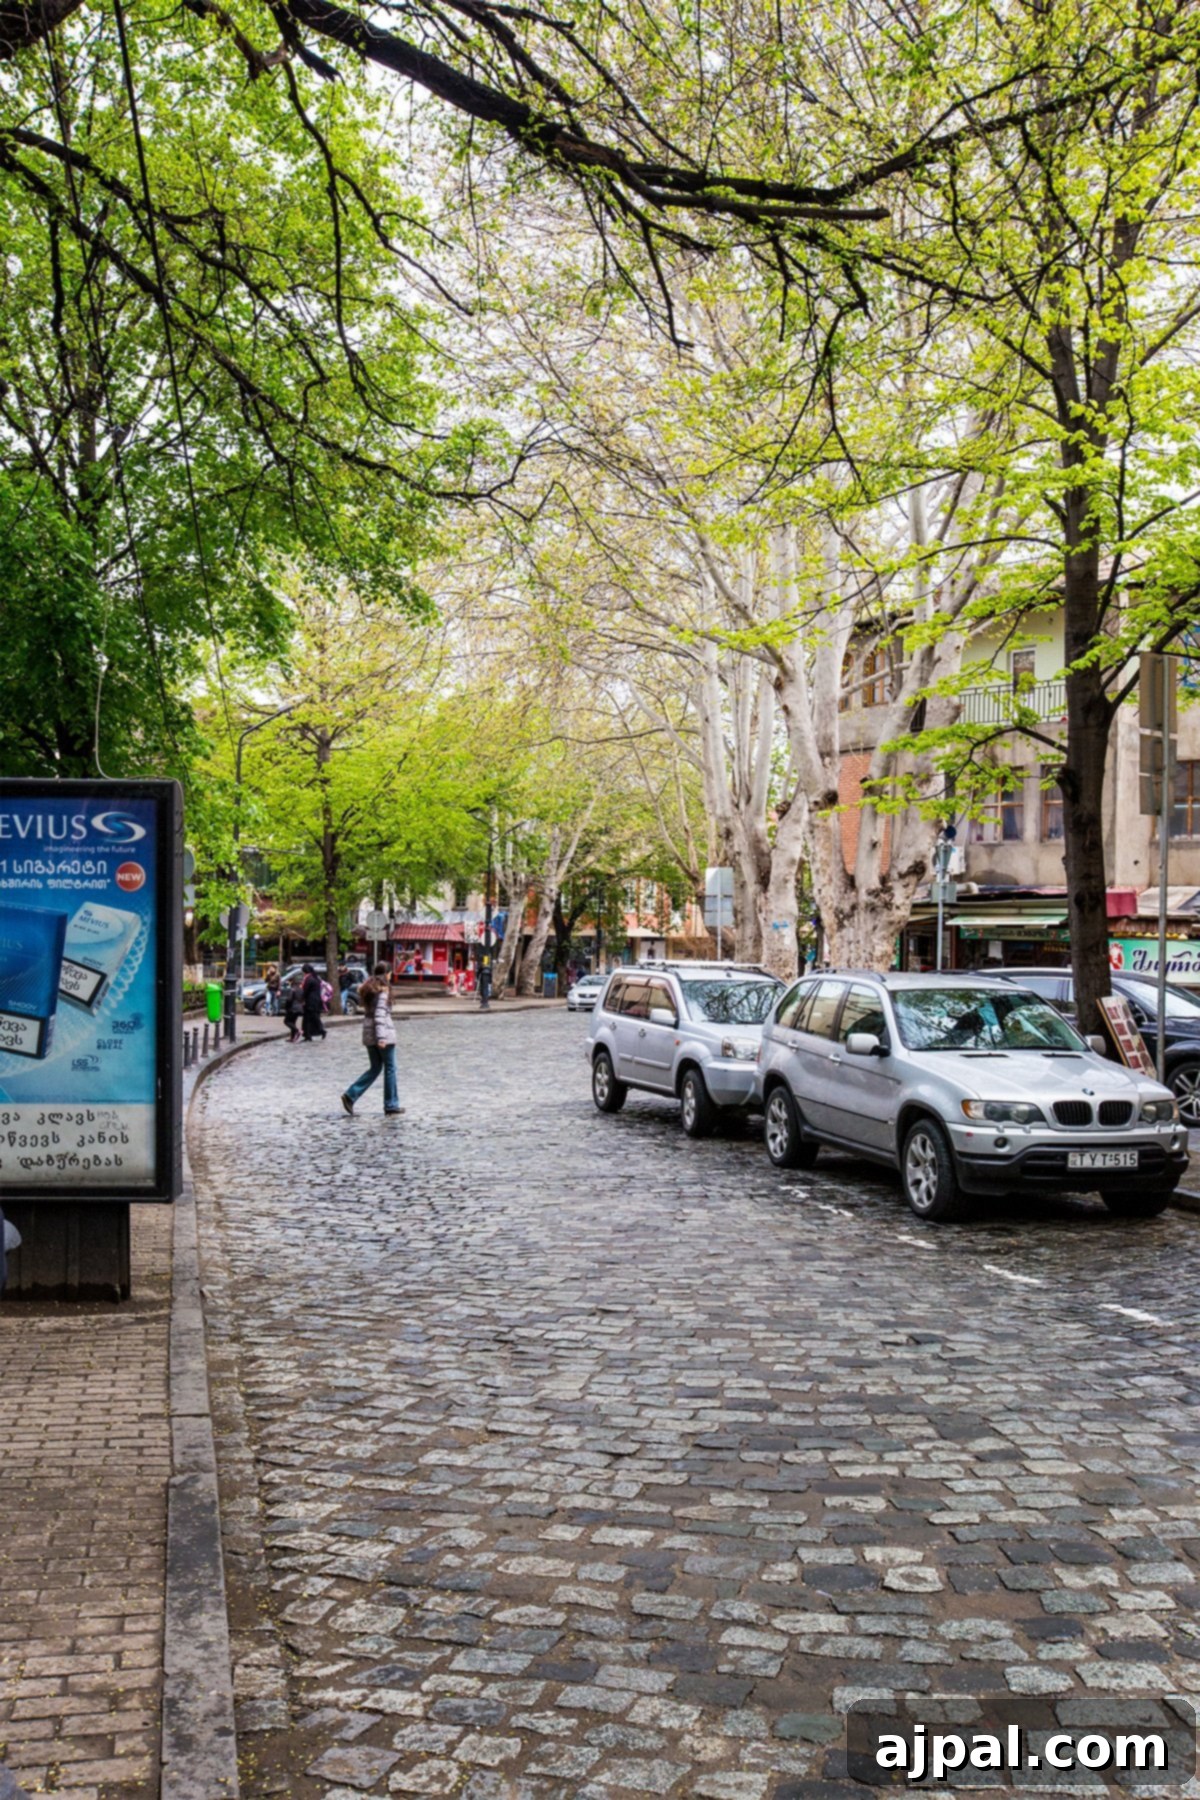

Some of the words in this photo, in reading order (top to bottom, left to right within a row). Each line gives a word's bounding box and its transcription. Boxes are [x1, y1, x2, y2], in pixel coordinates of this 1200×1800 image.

[0, 814, 87, 840] EVIUS
[97, 844, 109, 853] the
[111, 844, 136, 853] future
[117, 873, 142, 882] NEW
[79, 915, 109, 929] MEVIUS
[37, 1109, 96, 1126] კლავს
[76, 1131, 129, 1148] კანის
